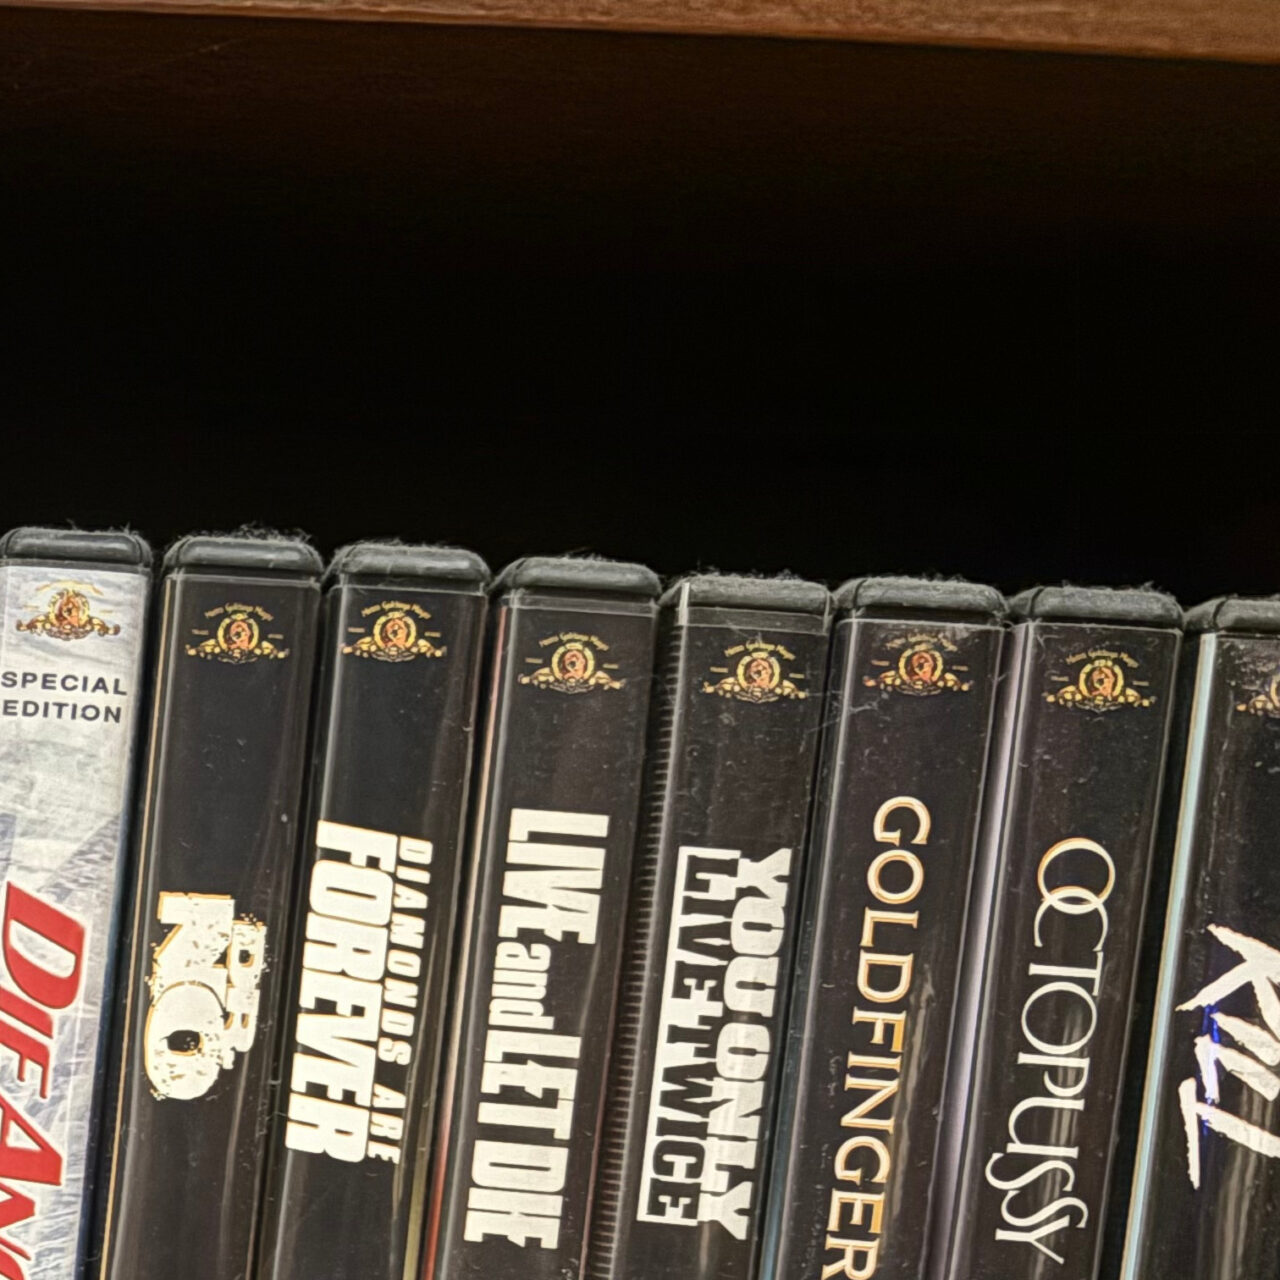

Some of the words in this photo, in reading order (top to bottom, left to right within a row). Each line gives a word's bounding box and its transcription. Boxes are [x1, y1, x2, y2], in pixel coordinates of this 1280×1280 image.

[0, 671, 128, 696] SPECIAL
[2, 700, 122, 723] EDITION
[497, 807, 610, 944] LIVE
[670, 853, 740, 1001] LIVE
[723, 847, 793, 1018] YOU
[144, 891, 235, 1100] NO
[284, 819, 399, 1164] FOREVER
[377, 835, 434, 1067] DIAMONDS
[488, 941, 555, 1031] and
[367, 1083, 407, 1166] ARE
[476, 1029, 583, 1141] LET
[645, 1013, 724, 1220] TWICE
[985, 836, 1117, 1266] OCTOPUSSY
[463, 1139, 570, 1250] DIE
[696, 1021, 771, 1241] ONLY
